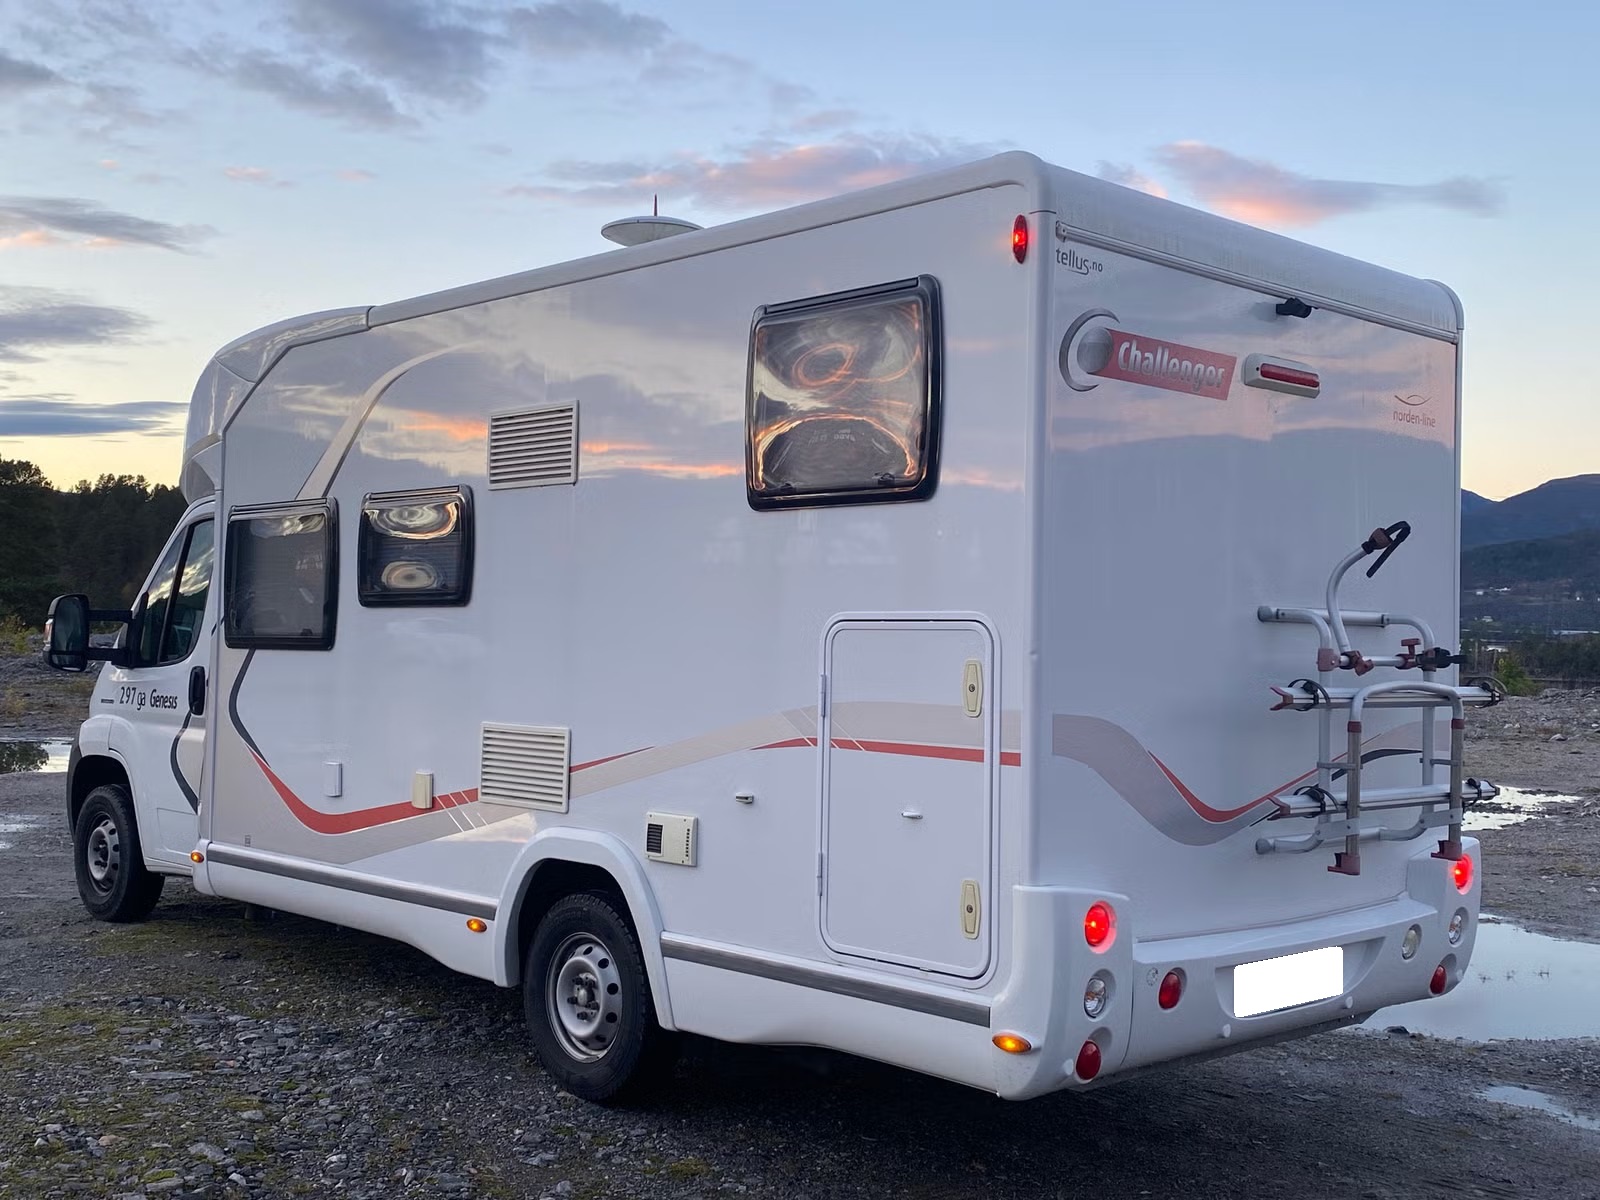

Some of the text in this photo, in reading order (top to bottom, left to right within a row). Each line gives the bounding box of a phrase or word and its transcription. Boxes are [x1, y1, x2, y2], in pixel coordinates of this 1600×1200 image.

[1055, 247, 1104, 276] tellus.no
[1117, 339, 1226, 393] Challenger
[1393, 409, 1437, 428] norden-line
[149, 688, 178, 710] Genesis
